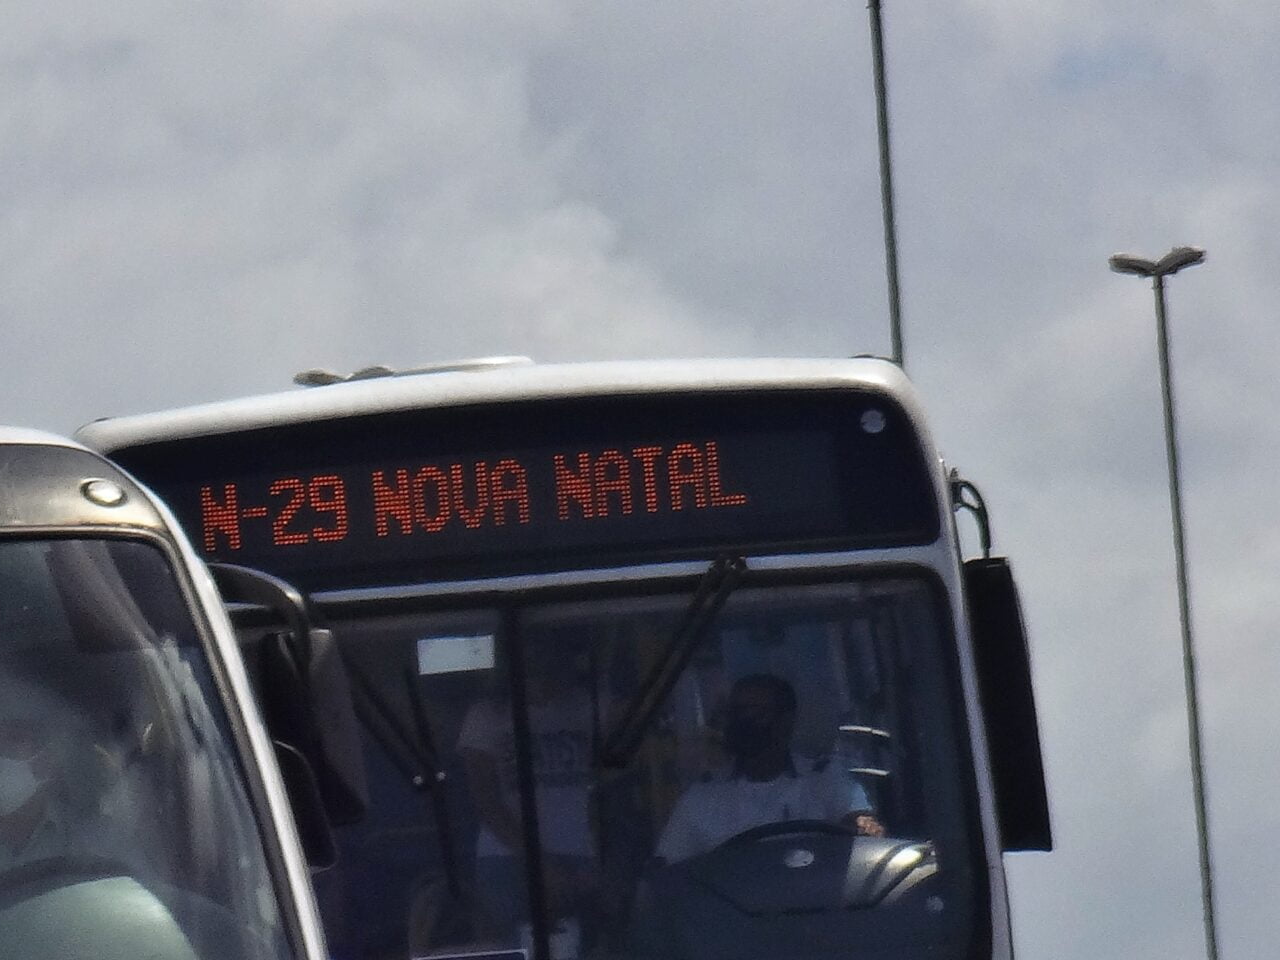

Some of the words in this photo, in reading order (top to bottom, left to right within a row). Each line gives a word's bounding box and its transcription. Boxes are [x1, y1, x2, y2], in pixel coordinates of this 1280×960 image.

[201, 474, 348, 553] N-29
[371, 458, 531, 536] NOVA
[553, 440, 747, 520] NATAL
